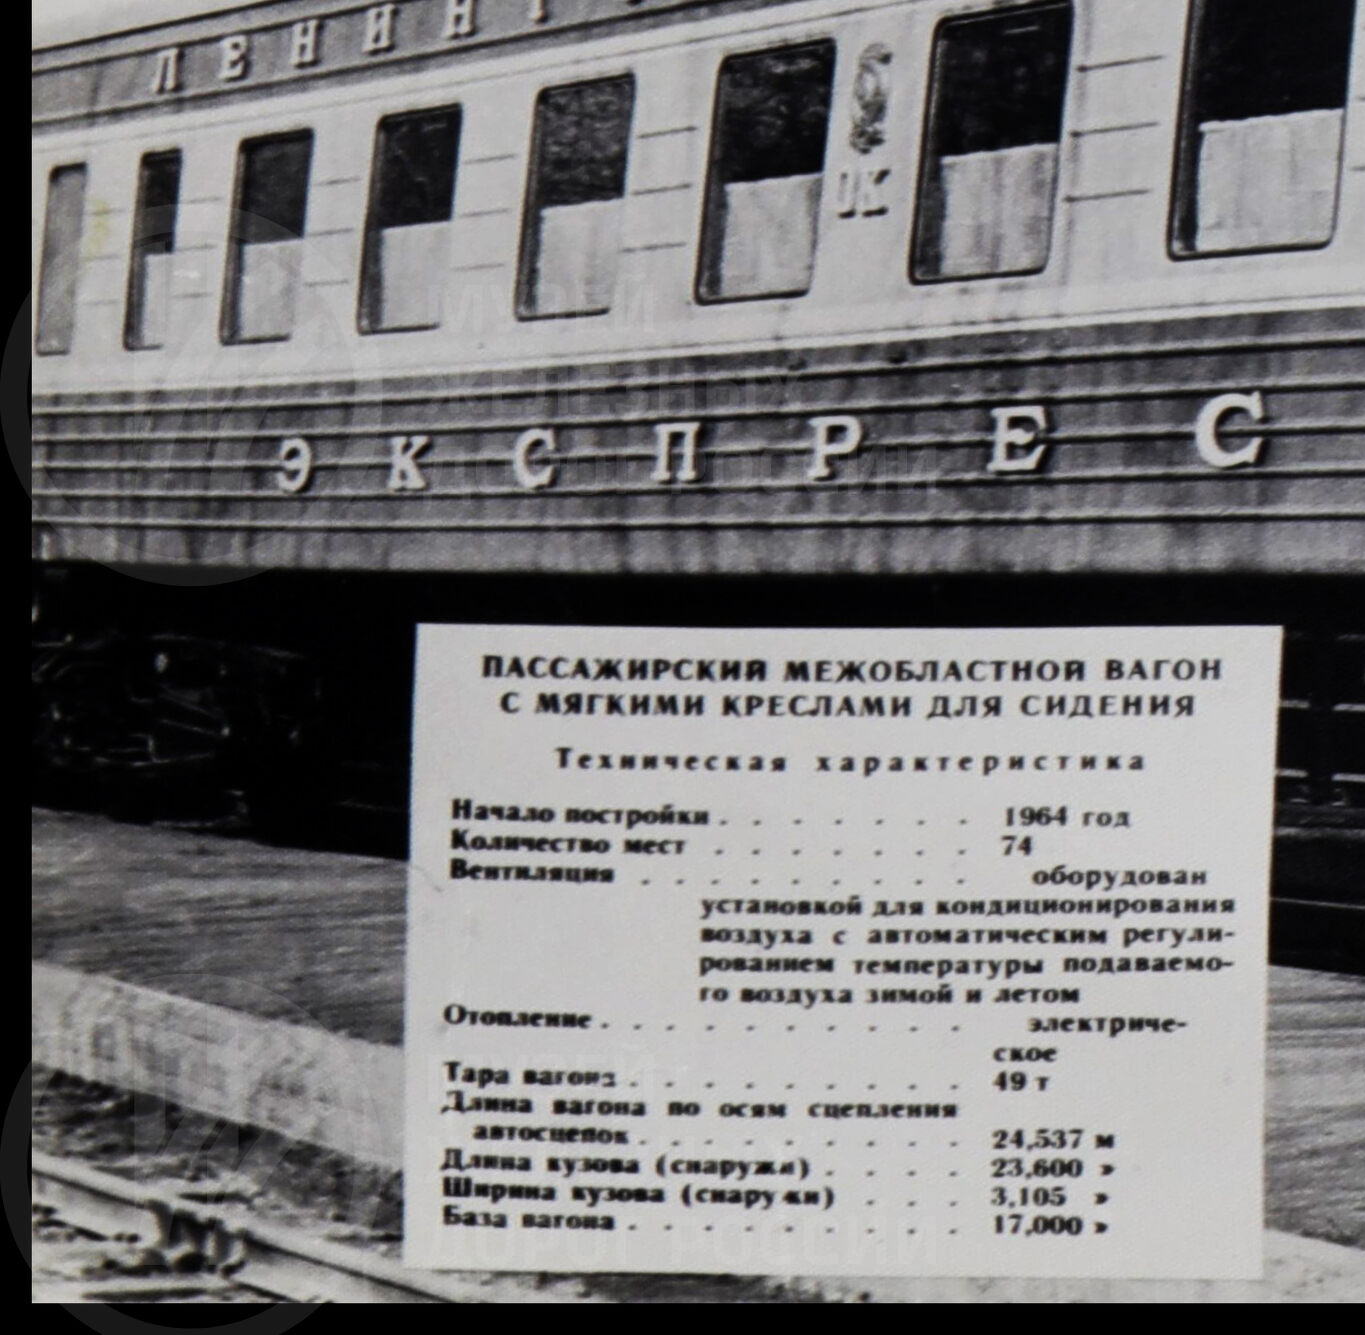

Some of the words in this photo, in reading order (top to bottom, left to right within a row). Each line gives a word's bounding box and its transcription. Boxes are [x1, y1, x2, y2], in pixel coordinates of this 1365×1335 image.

[481, 653, 768, 683] ПАССАЖИРСКИЙ
[783, 658, 1086, 684] МЕЖОБЛАСТНОЙ
[1104, 658, 1222, 682] ВАГОН
[534, 691, 705, 717] МЯГКИМИ
[721, 693, 912, 718] КРЕСЛАМИ
[926, 694, 1003, 720] ДЛЯ
[1019, 694, 1195, 719] СИДЕНИЯ
[555, 746, 787, 773] Техническая
[816, 754, 1144, 778] характеристика
[450, 797, 557, 824] Начало
[564, 803, 710, 831] постройки
[1005, 805, 1068, 828] 1964
[1082, 810, 1130, 828] год
[449, 827, 612, 855] Количество
[623, 838, 686, 856] мест
[1001, 834, 1033, 857] 74
[448, 856, 616, 885] Вентиляция
[1031, 863, 1207, 893] оборудован
[700, 894, 864, 921] установкой
[871, 899, 925, 918] для
[935, 897, 1236, 920] кондиционирования
[699, 926, 814, 951] воздуха
[866, 927, 1108, 945] автоматическим
[1122, 926, 1234, 950] регули-
[698, 955, 836, 978] рованием
[853, 958, 1045, 981] температуры
[1062, 956, 1234, 975] подаваемо-
[699, 986, 730, 1003] го
[739, 987, 854, 1010] воздуха
[868, 982, 954, 1005] зимой
[993, 987, 1081, 1004] летом
[442, 1003, 593, 1030] Отопление
[1029, 1015, 1188, 1039] электриче-
[992, 1046, 1058, 1064] ское
[444, 1059, 511, 1090] Тара
[993, 1070, 1028, 1093] 49
[439, 1088, 534, 1115] Длина
[551, 1098, 648, 1118] вагона
[666, 1100, 702, 1117] по
[718, 1102, 788, 1119] осям
[807, 1102, 958, 1120] сцепления
[472, 1124, 630, 1146] автосцепок
[992, 1127, 1084, 1152] 24,537
[439, 1147, 533, 1173] Длина
[545, 1156, 641, 1179] кузова
[991, 1157, 1085, 1180] 23,600
[441, 1175, 558, 1205] Ширина
[570, 1185, 667, 1209] кузова
[992, 1185, 1068, 1209] 3,105
[441, 1203, 509, 1230] База
[520, 1212, 616, 1232] вагона
[994, 1212, 1084, 1237] 17,000
